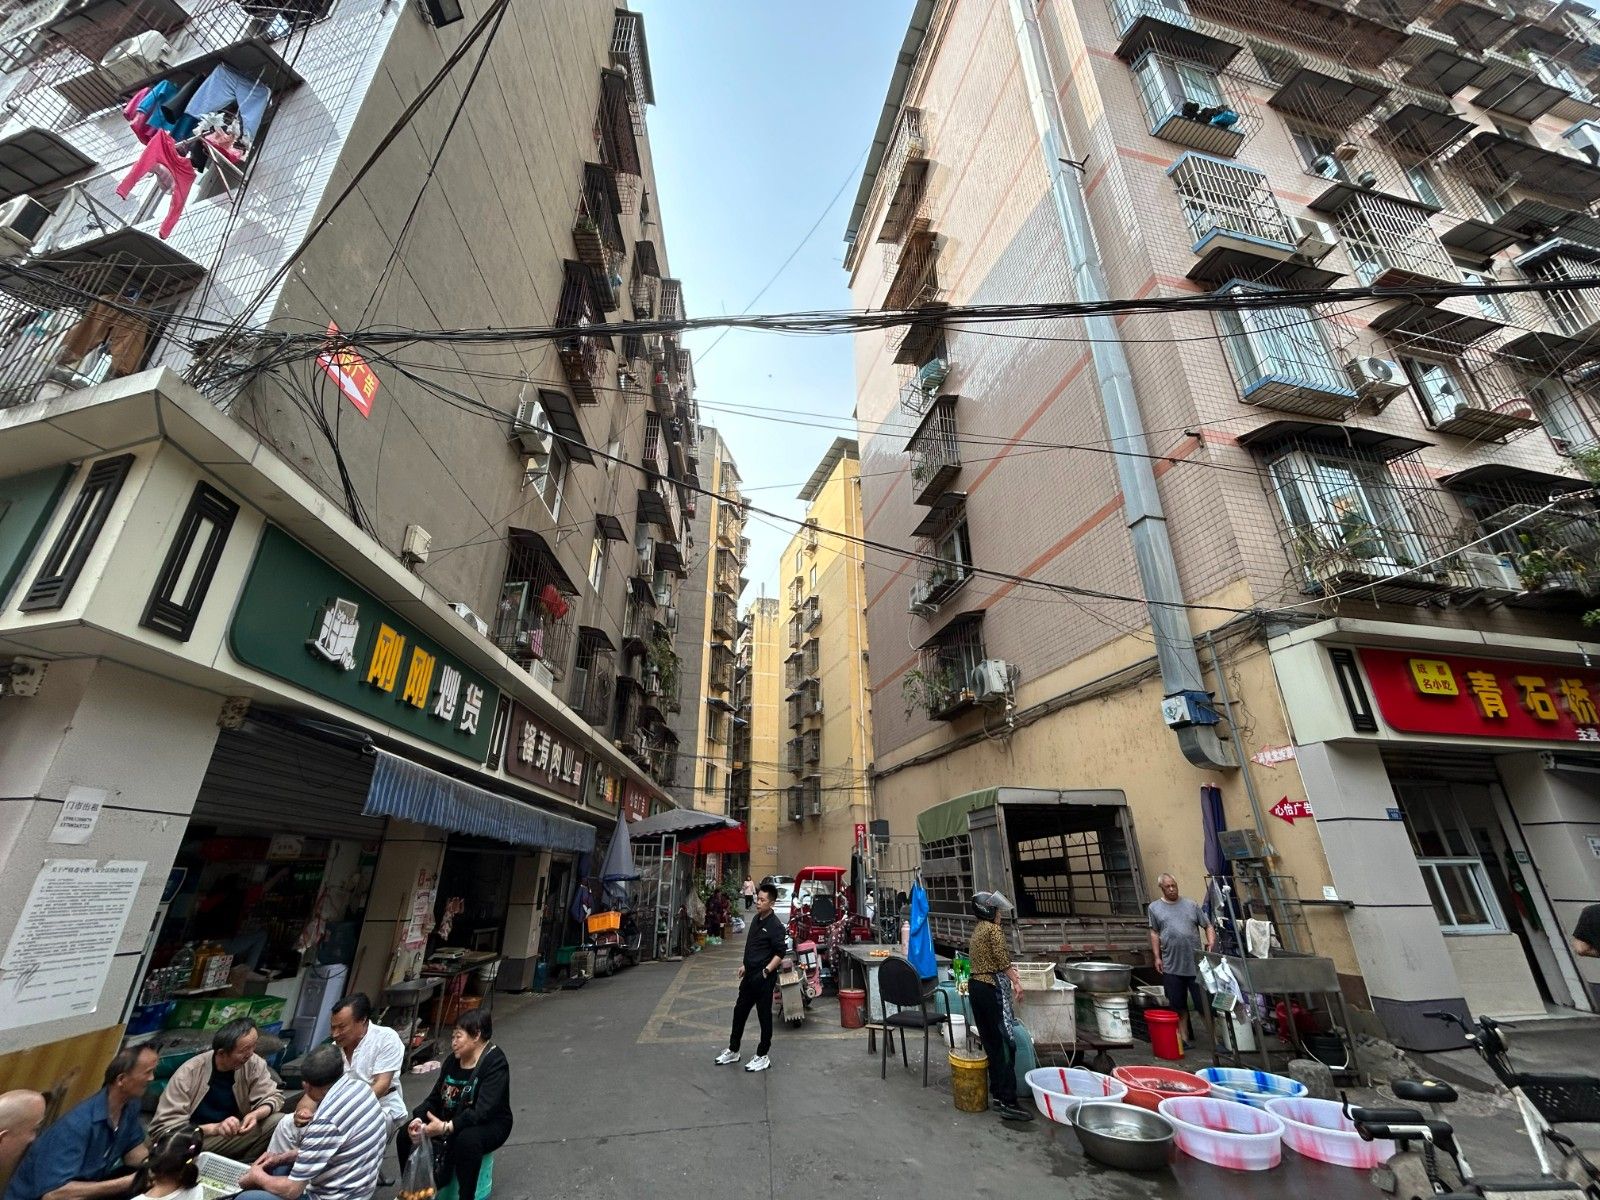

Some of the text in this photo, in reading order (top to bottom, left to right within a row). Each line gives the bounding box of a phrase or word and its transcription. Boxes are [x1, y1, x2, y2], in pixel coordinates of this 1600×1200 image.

[1416, 664, 1447, 676] 成都
[367, 622, 484, 736] 刚刚炒货
[1423, 678, 1453, 691] 名小吃
[1465, 670, 1600, 725] 青石桥
[1575, 727, 1600, 742] 主营
[65, 801, 100, 812] 门市出租
[1274, 801, 1313, 817] 心怡广告
